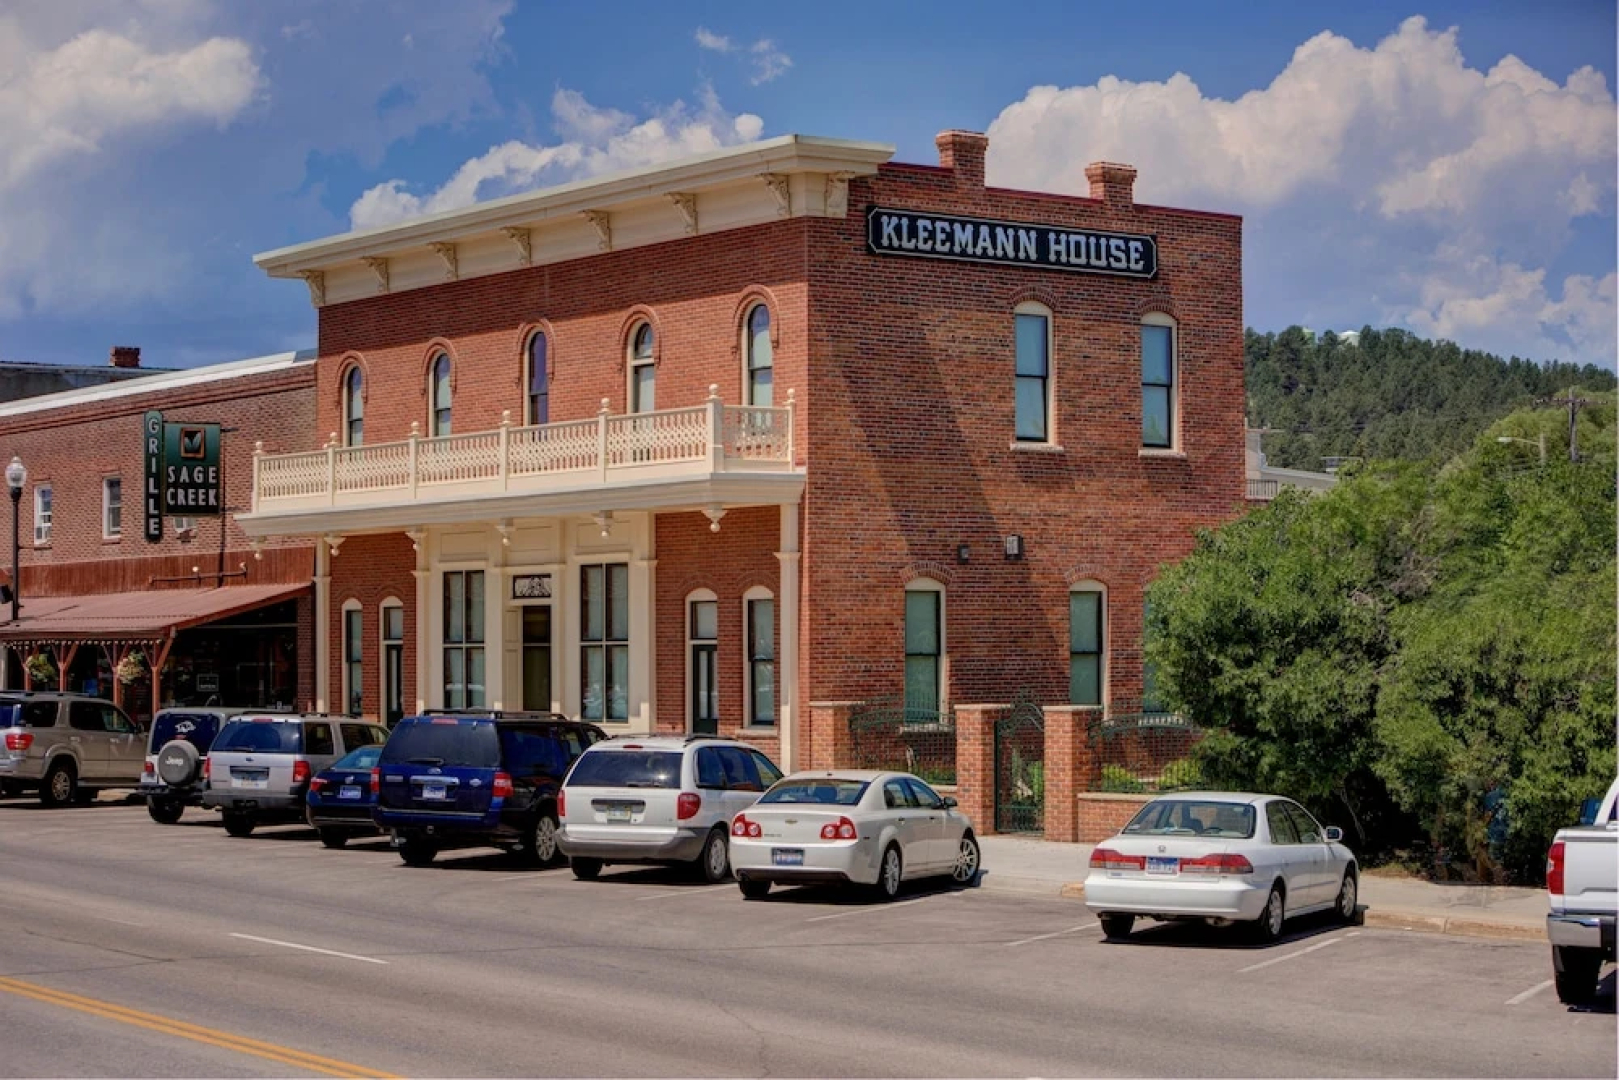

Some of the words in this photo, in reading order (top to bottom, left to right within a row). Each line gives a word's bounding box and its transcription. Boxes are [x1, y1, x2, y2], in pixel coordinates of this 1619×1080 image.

[880, 215, 1038, 260] KLEEMANN
[1048, 231, 1144, 270] HOUSE
[148, 418, 159, 535] GRILLE
[167, 466, 217, 484] SAGE
[166, 488, 218, 506] CREEK
